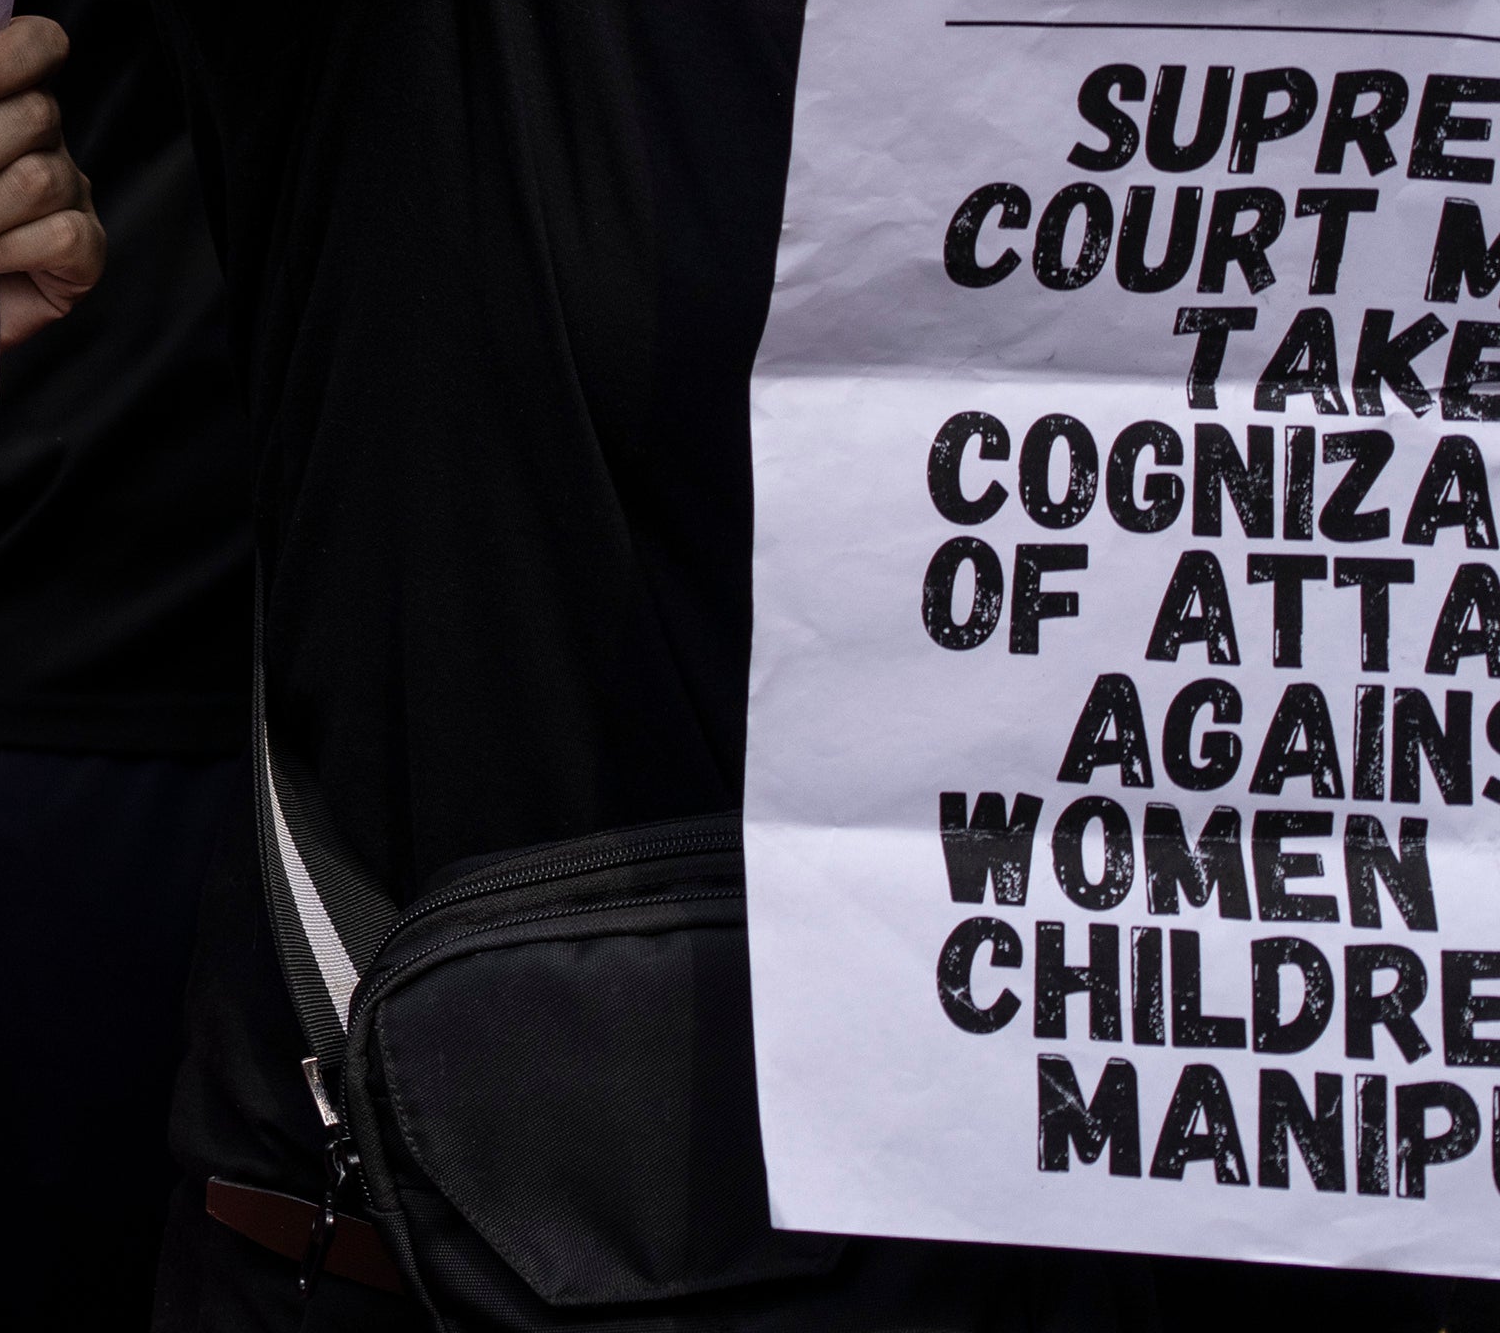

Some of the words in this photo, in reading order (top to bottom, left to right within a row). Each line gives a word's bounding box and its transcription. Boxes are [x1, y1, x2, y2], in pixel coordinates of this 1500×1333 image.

[944, 182, 1378, 294] COURT
[921, 536, 1089, 655] OF
[1057, 673, 1500, 808] AGAIN
[938, 791, 1439, 933] WOMEN
[1036, 1053, 1500, 1199] MANIP
